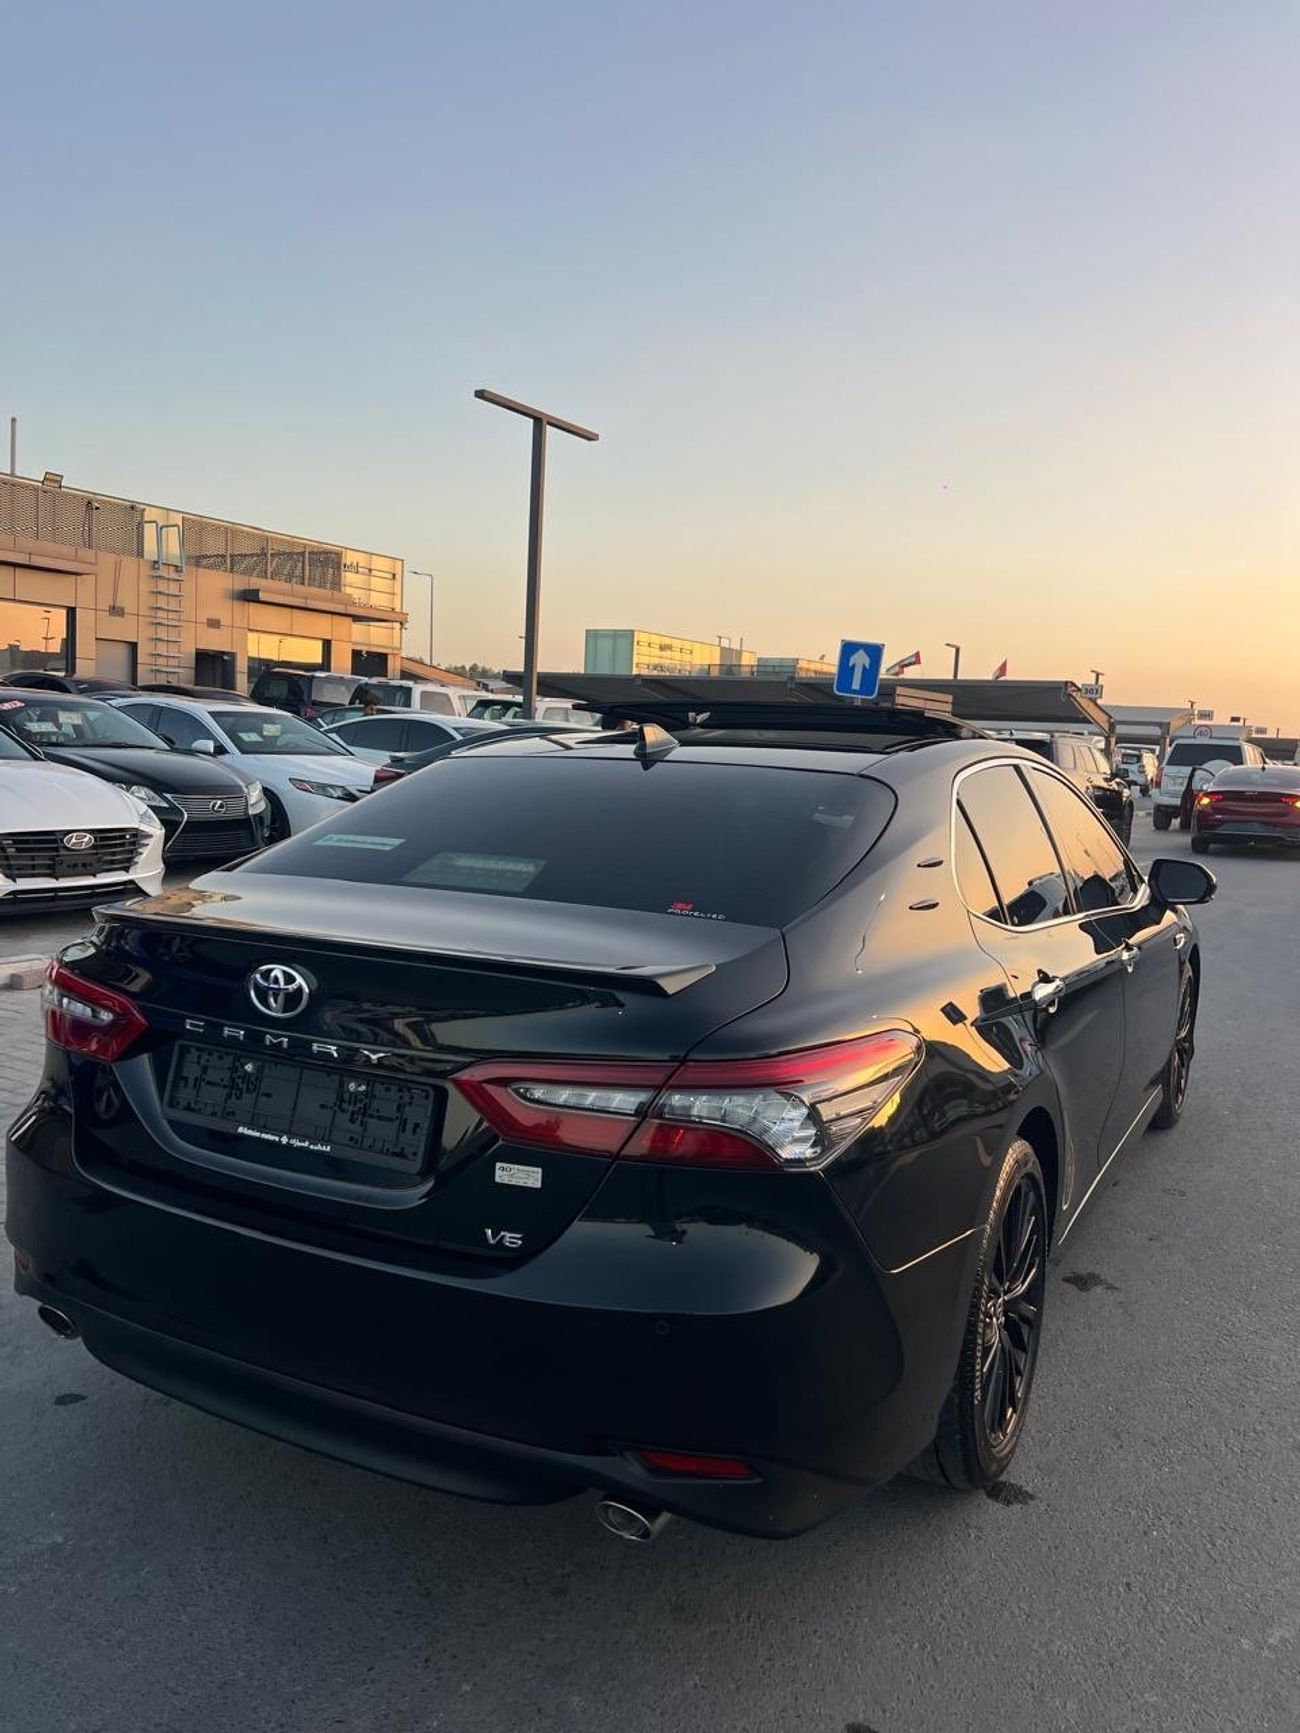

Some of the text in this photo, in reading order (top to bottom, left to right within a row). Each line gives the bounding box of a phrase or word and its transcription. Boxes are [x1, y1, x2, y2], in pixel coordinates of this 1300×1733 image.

[1197, 729, 1209, 737] 40
[185, 1018, 391, 1063] CAMRY
[485, 1228, 523, 1248] V6
